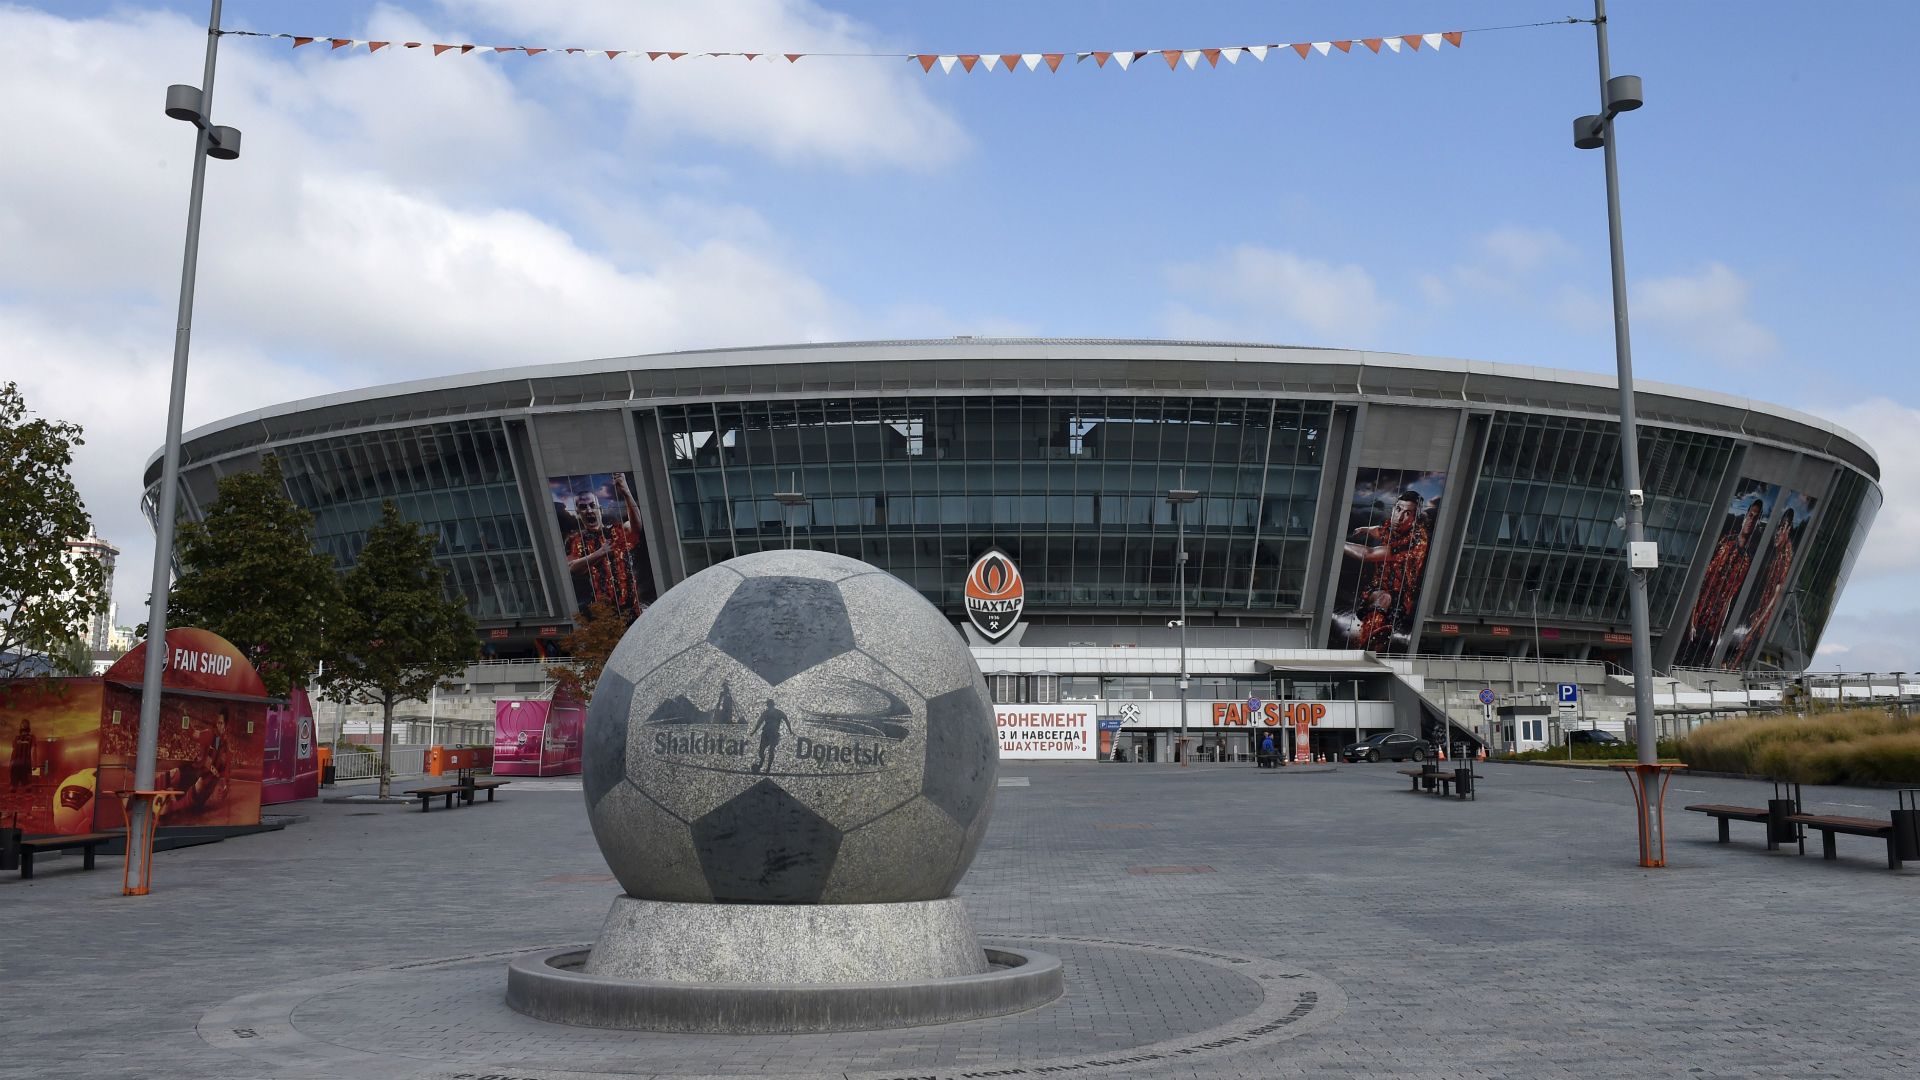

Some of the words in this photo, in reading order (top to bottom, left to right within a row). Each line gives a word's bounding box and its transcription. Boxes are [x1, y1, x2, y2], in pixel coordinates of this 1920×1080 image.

[968, 598, 1022, 612] ШАХТАР
[173, 648, 198, 672] FAN
[200, 652, 232, 676] SHOP
[1562, 685, 1573, 700] P
[1264, 703, 1326, 726] SHOP
[1010, 731, 1017, 740] И
[1022, 731, 1080, 741] НАВСЕГДА
[654, 731, 748, 756] Shakhtar
[795, 737, 886, 766] Donetsk
